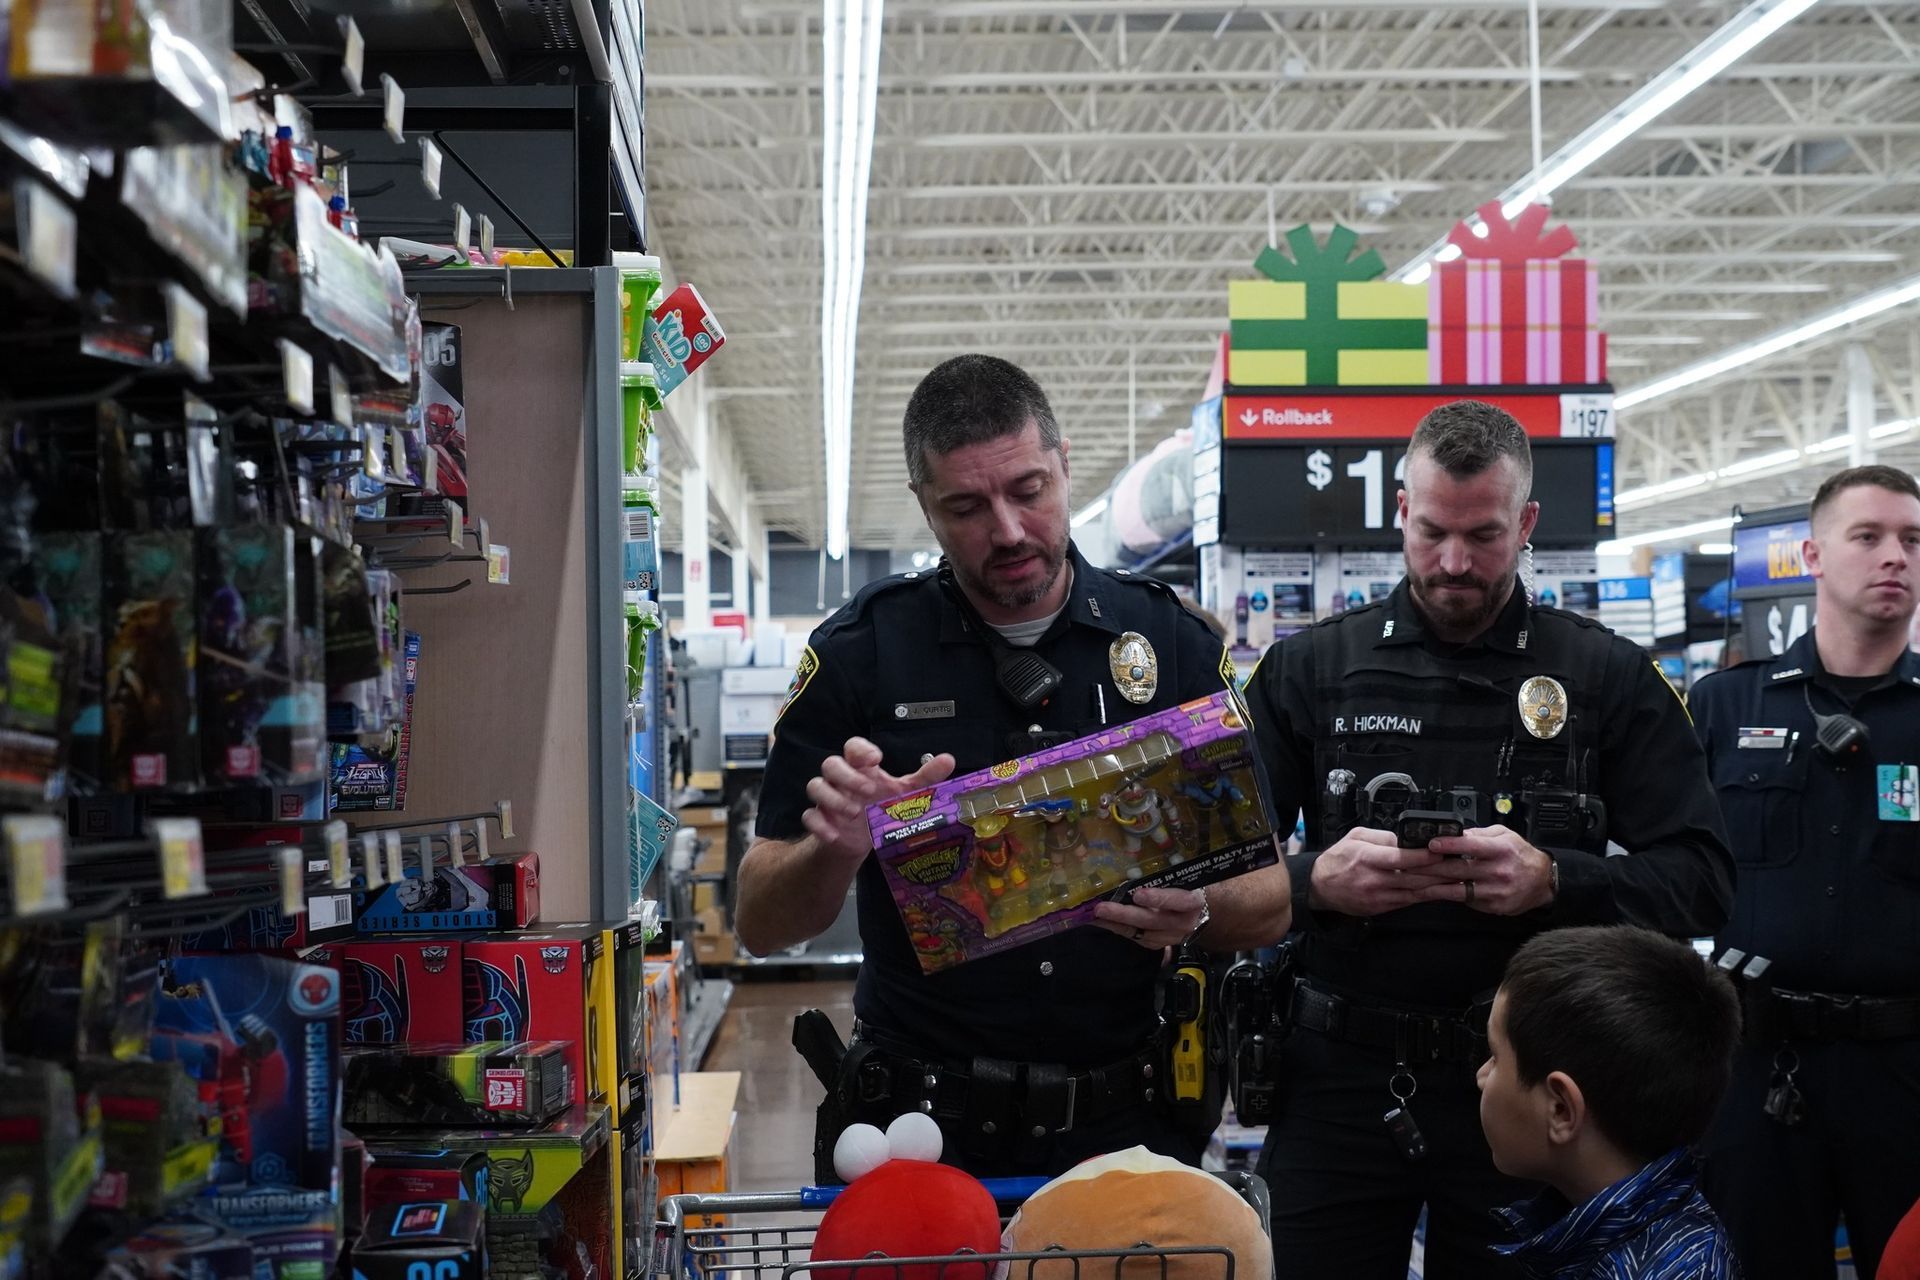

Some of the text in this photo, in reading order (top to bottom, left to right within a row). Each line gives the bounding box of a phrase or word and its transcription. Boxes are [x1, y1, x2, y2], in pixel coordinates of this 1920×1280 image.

[657, 313, 691, 362] KID
[652, 333, 675, 367] Connection
[648, 350, 660, 370] Food
[659, 366, 671, 383] Set
[1262, 407, 1333, 426] Rollback
[923, 704, 952, 714] CURTIS
[1334, 715, 1422, 734] R. HICKMAN
[346, 765, 388, 780] LEGACY
[341, 785, 388, 796] EVOLUTION
[885, 828, 910, 840] TURTLES
[896, 822, 936, 840] PARTY PACK
[1164, 874, 1175, 882] IN
[1176, 860, 1212, 878] DISGUISE
[1213, 848, 1243, 864] PARTY
[1245, 840, 1269, 853] PACK
[360, 913, 494, 930] STUDIO SERIES
[304, 1022, 329, 1151] TRANSFORMERS
[211, 1190, 328, 1213] TRANSFORMERS
